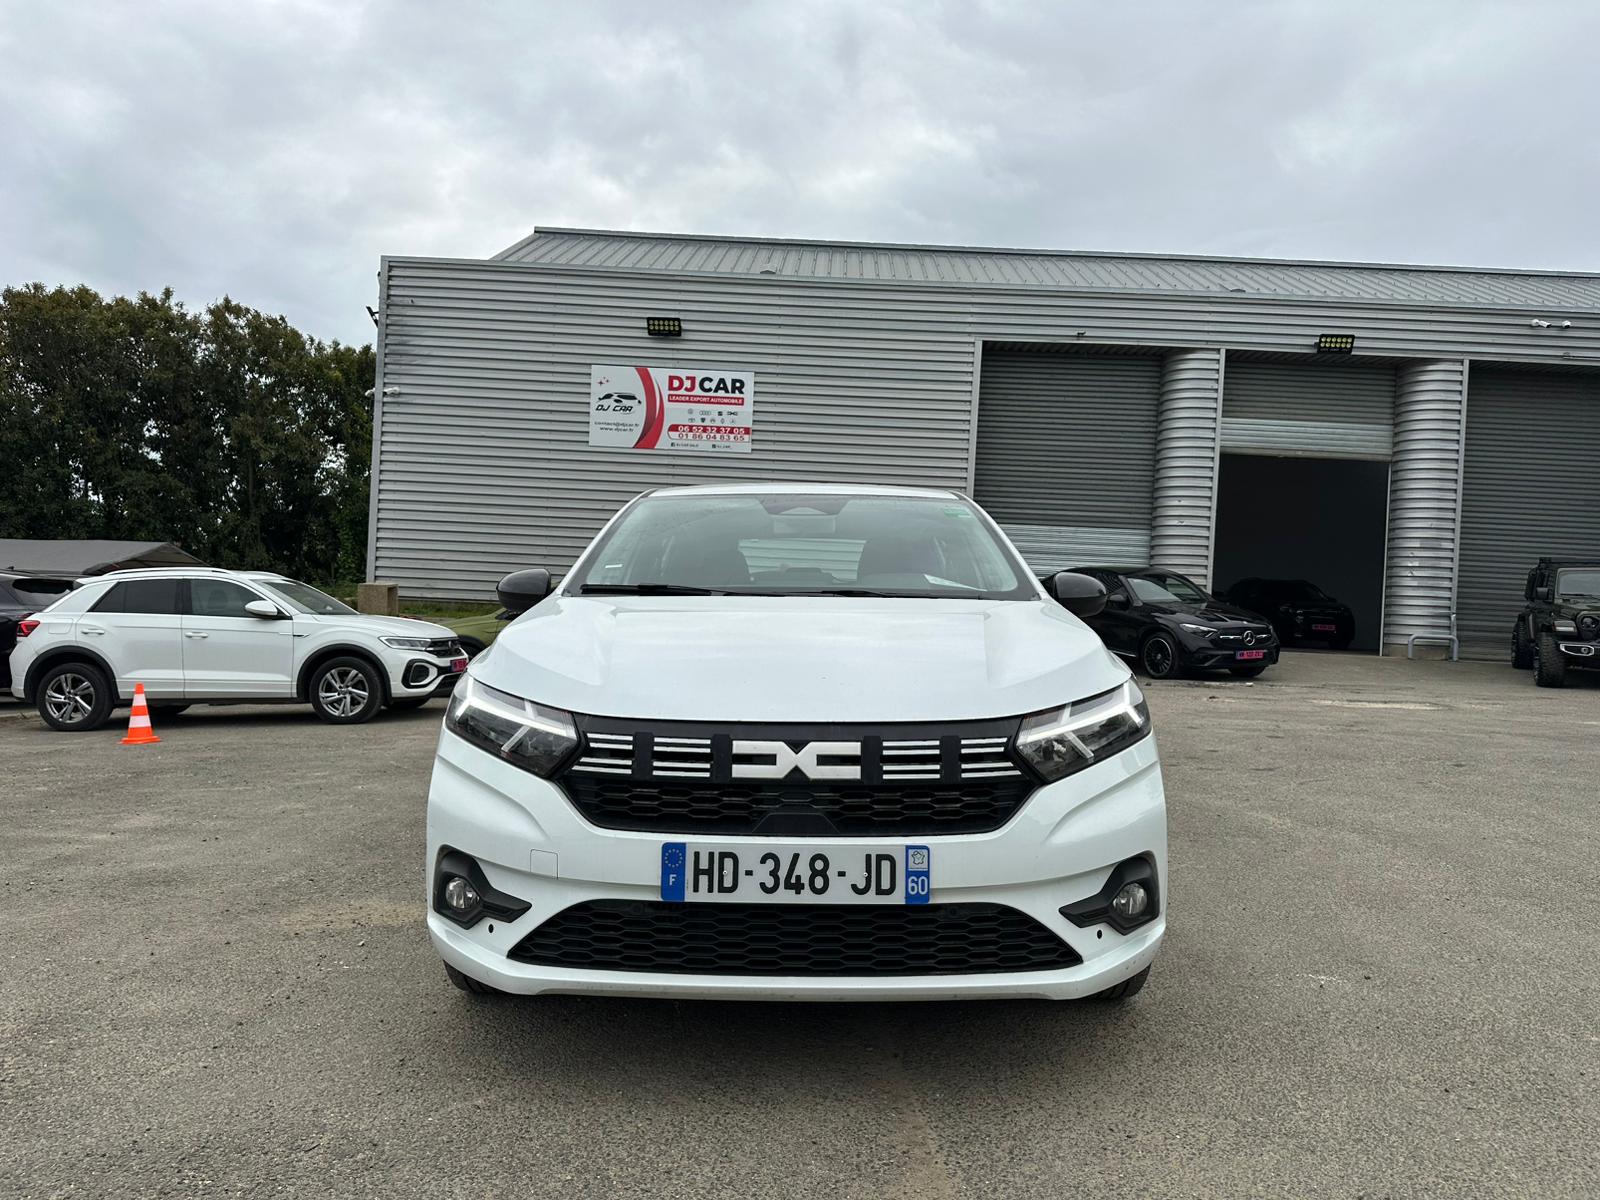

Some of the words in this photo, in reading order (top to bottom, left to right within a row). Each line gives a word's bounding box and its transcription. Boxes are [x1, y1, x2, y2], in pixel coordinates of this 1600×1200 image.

[668, 375, 696, 392] DJ
[699, 377, 745, 394] CAR
[595, 404, 611, 412] DJ
[669, 874, 677, 886] F
[693, 851, 896, 895] HD-348-JD
[908, 876, 928, 895] 60
